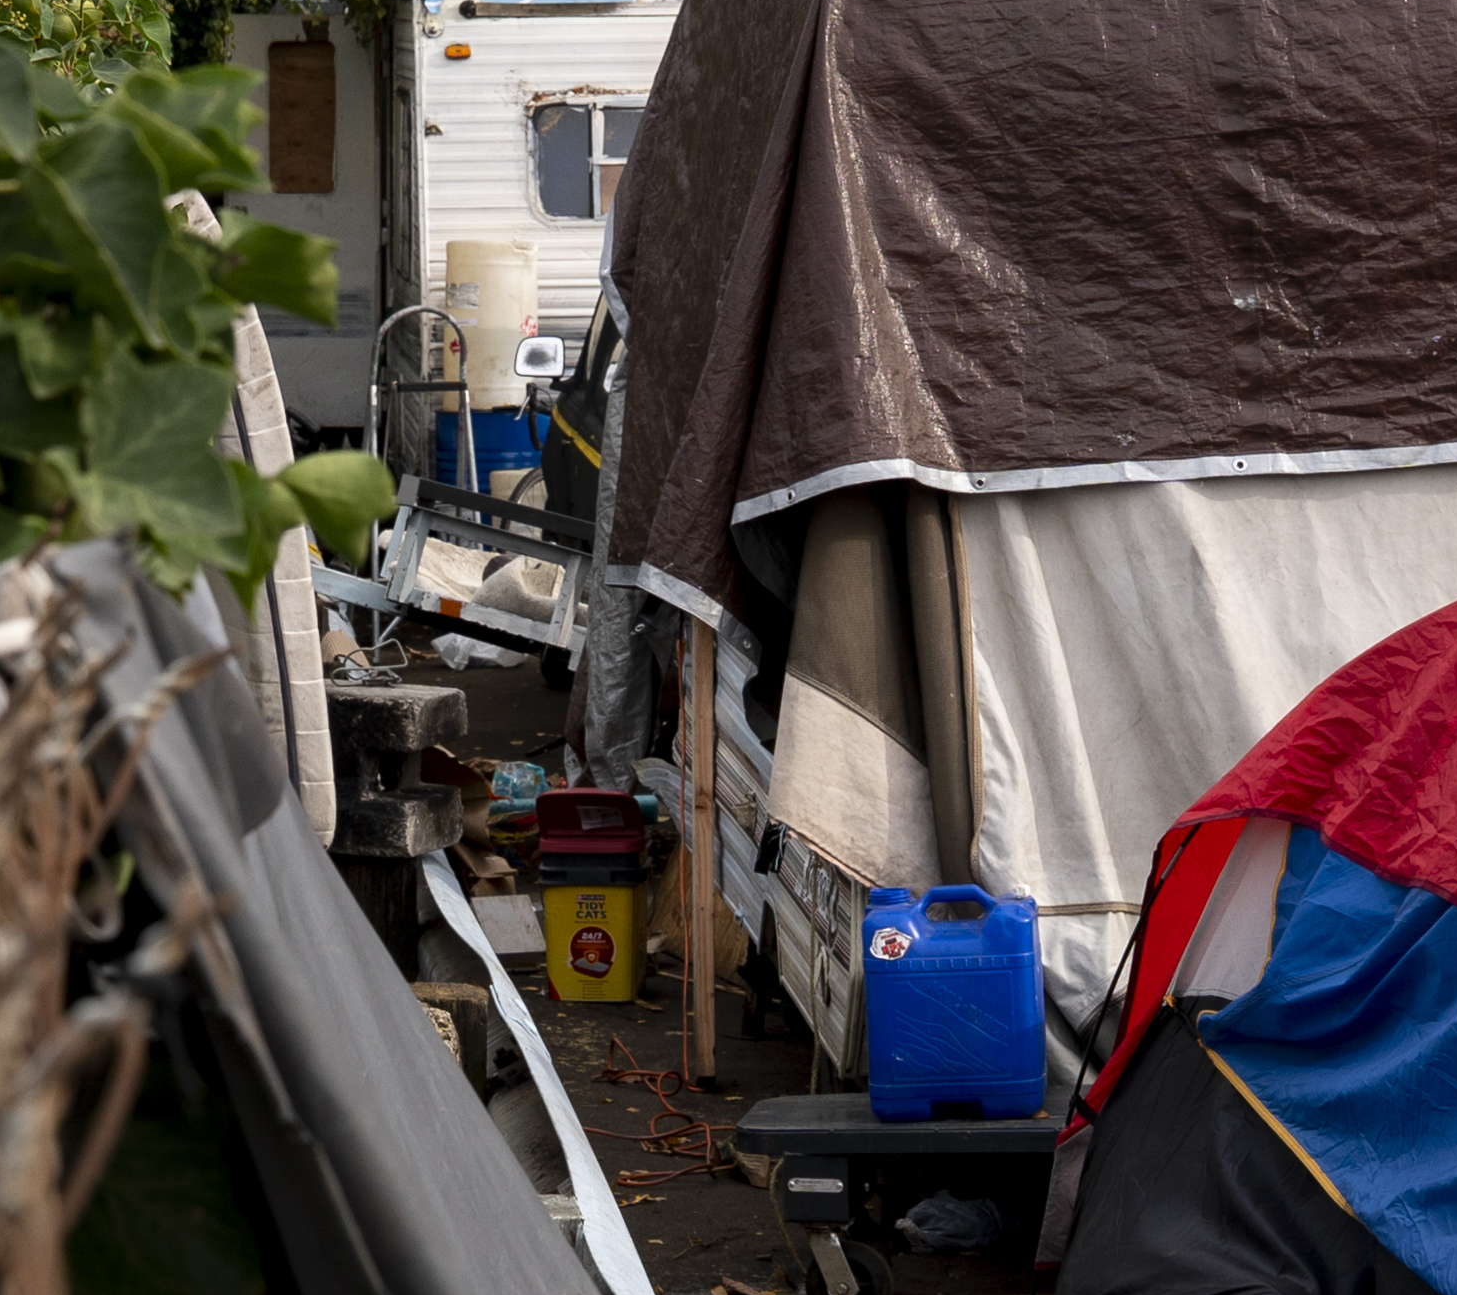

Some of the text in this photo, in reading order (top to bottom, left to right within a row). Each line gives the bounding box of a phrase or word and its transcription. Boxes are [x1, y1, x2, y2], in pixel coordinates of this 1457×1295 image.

[576, 902, 606, 911] TIDY
[576, 910, 607, 920] CATS
[582, 932, 604, 940] 24/7
